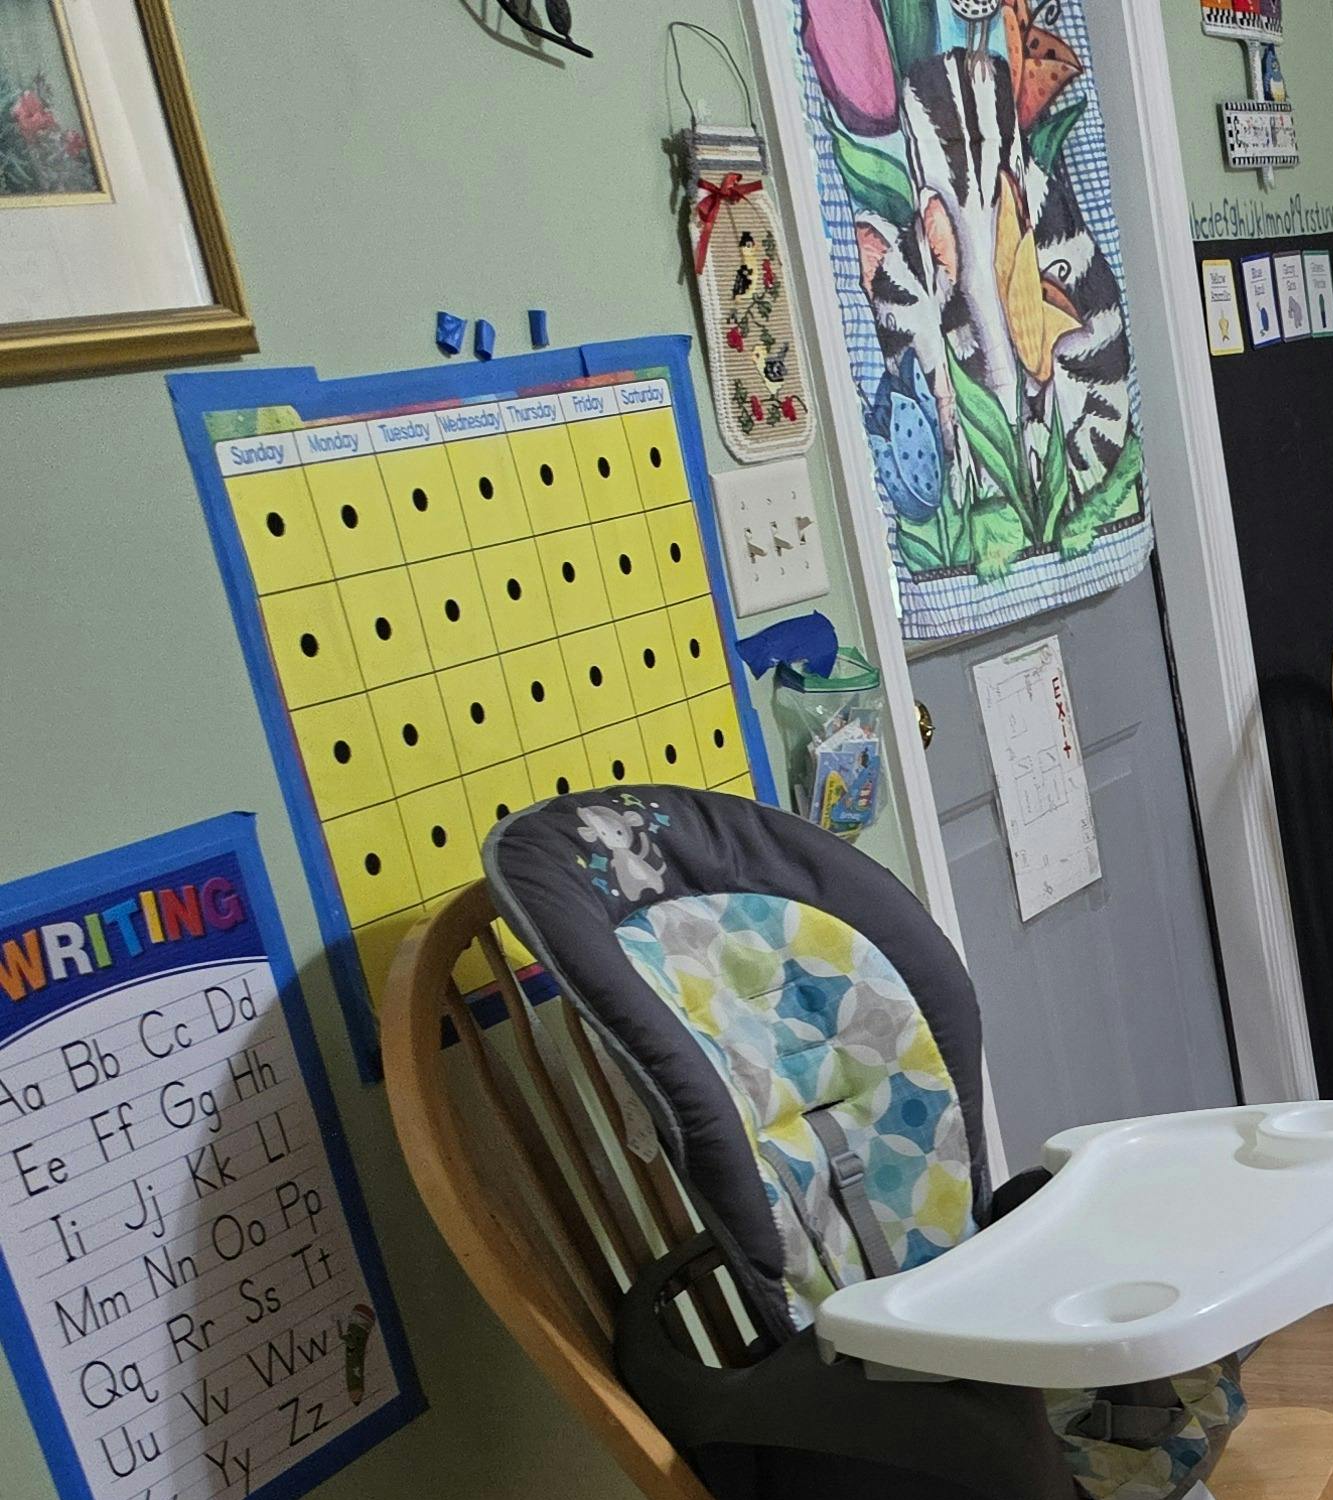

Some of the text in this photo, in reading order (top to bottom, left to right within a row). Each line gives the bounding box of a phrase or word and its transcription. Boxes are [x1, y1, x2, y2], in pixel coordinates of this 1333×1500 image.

[230, 385, 663, 466] Sunday Monday Tuesday Wednesday Thursday Friday Saturday
[0, 876, 246, 1002] WRITING
[61, 1038, 121, 1093] Bb
[138, 1010, 192, 1059] Cc
[204, 978, 258, 1034] Dd
[12, 1049, 277, 1197] Ee Ff Gg Hh
[50, 1111, 293, 1264] Ii Jj Kk Ll
[54, 1180, 322, 1346] Mm Nn Oo Pp
[79, 1243, 333, 1409] Qq Rr Ss Tt
[99, 1327, 328, 1478] Uu Vv Ww
[204, 1440, 251, 1495] Yy
[278, 1396, 330, 1448] Zz
